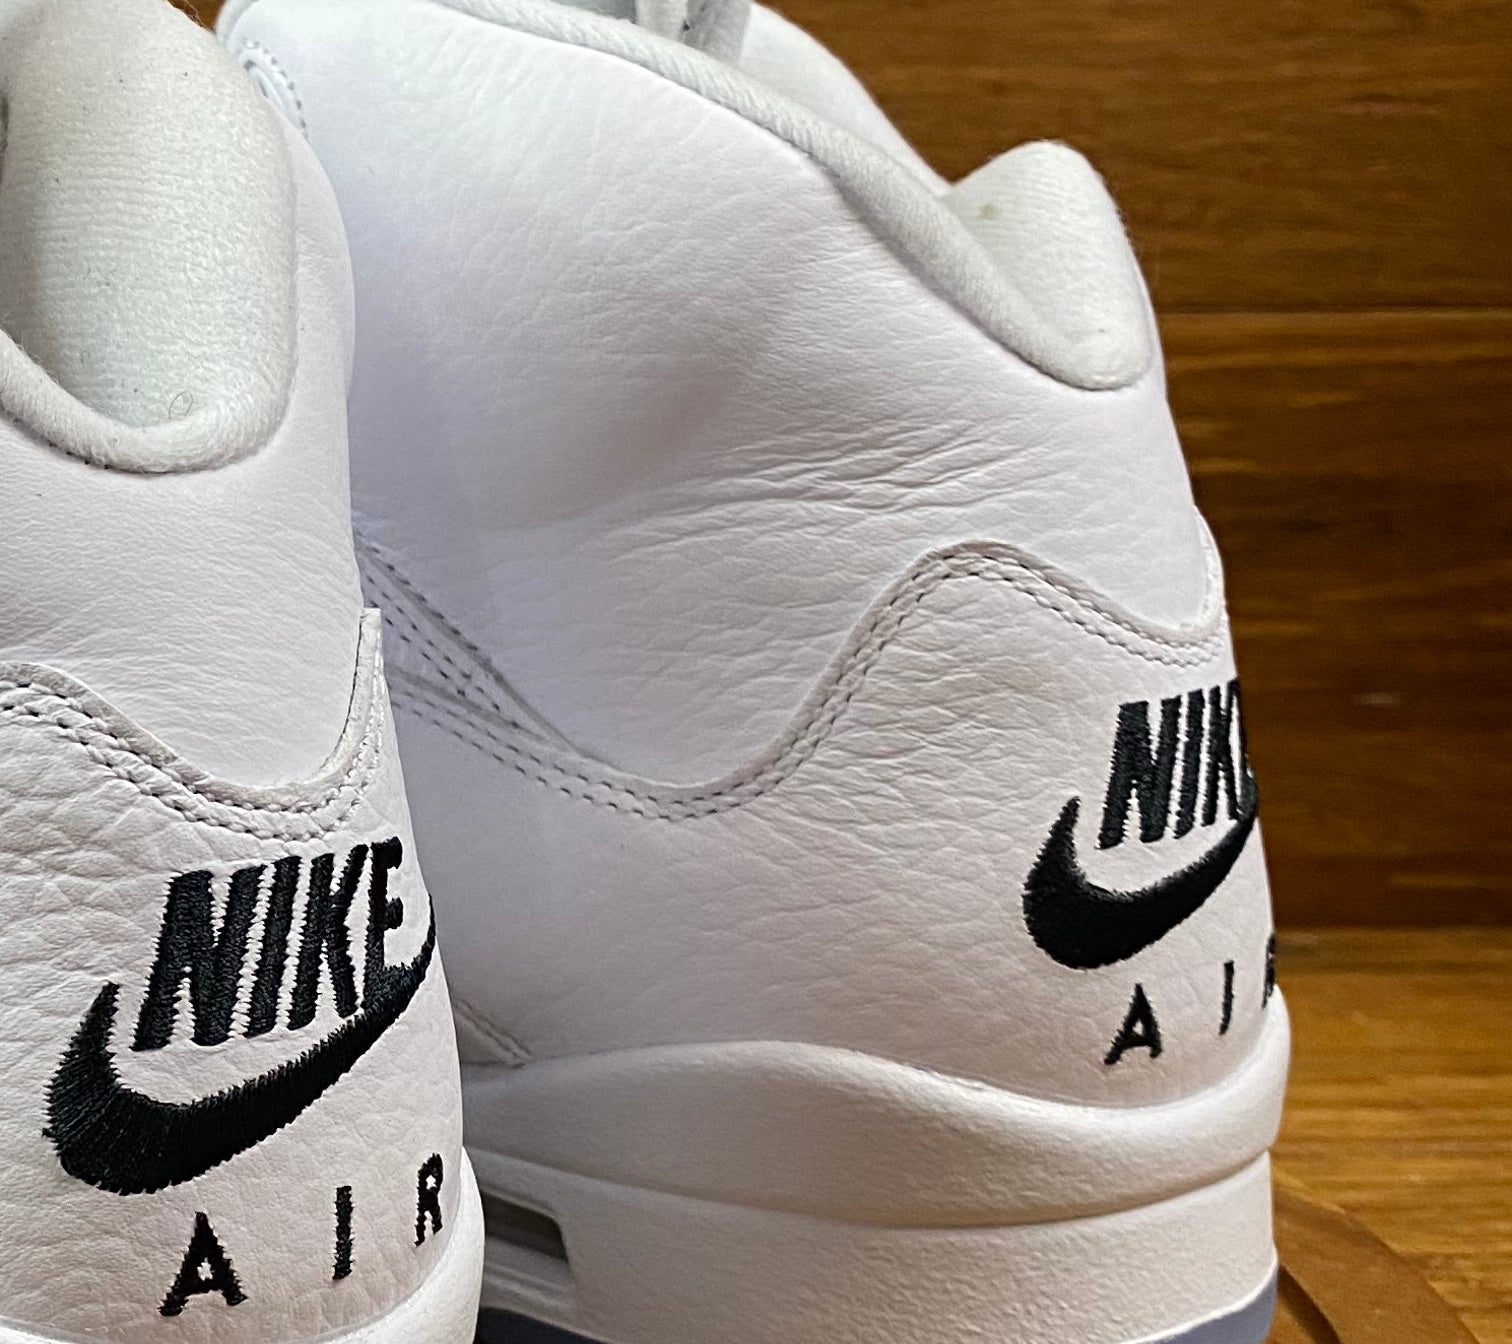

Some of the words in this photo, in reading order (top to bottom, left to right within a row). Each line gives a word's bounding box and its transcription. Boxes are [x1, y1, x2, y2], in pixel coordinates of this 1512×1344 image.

[1095, 676, 1249, 851] NIK
[129, 835, 405, 1052] NIKE
[158, 1153, 445, 1317] AIR
